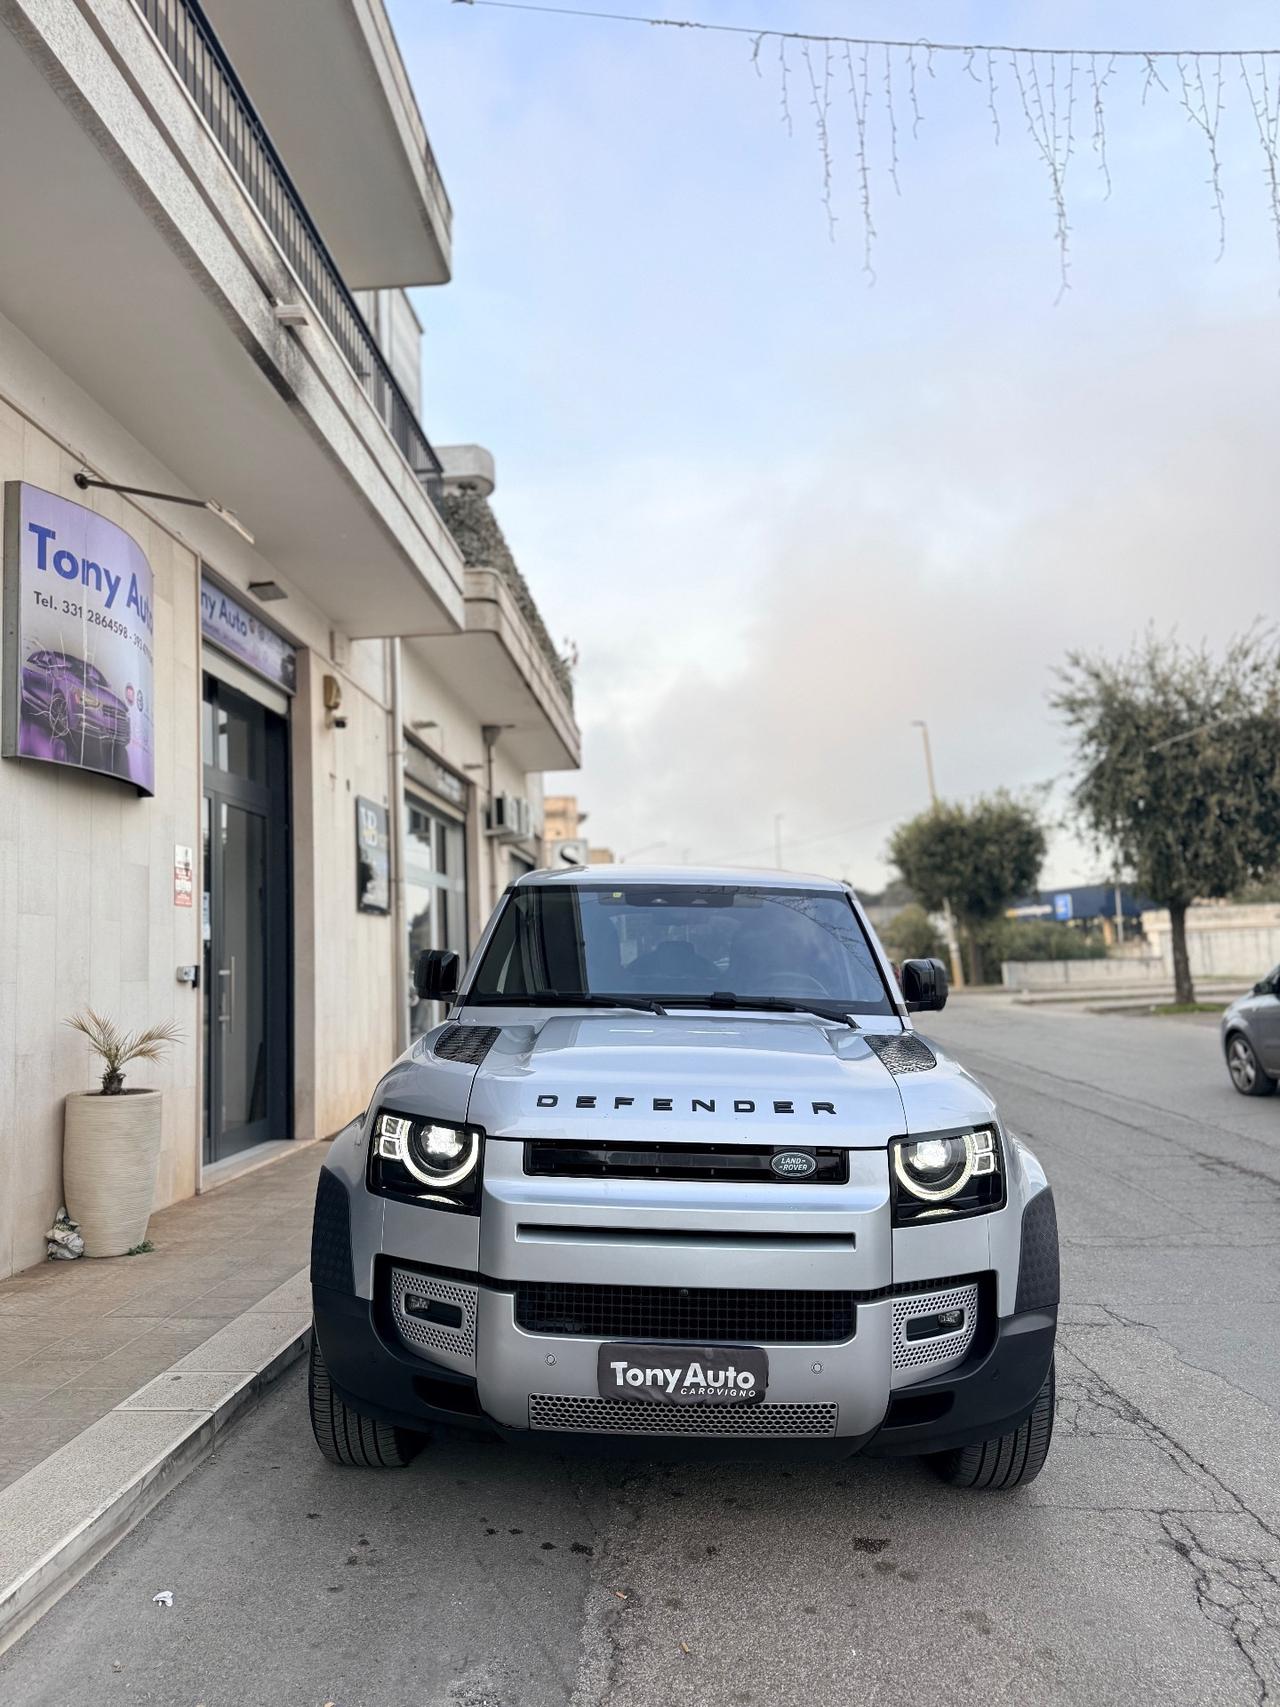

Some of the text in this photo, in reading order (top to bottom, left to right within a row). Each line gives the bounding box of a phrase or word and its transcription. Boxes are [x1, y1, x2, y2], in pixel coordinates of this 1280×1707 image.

[28, 522, 121, 609] Tony
[33, 590, 58, 611] Tel.
[62, 600, 83, 619] 331
[87, 609, 128, 640] 2864598
[219, 597, 247, 637] Auto
[536, 1094, 838, 1115] DEFENDER
[680, 1387, 757, 1397] CAROVIGNO
